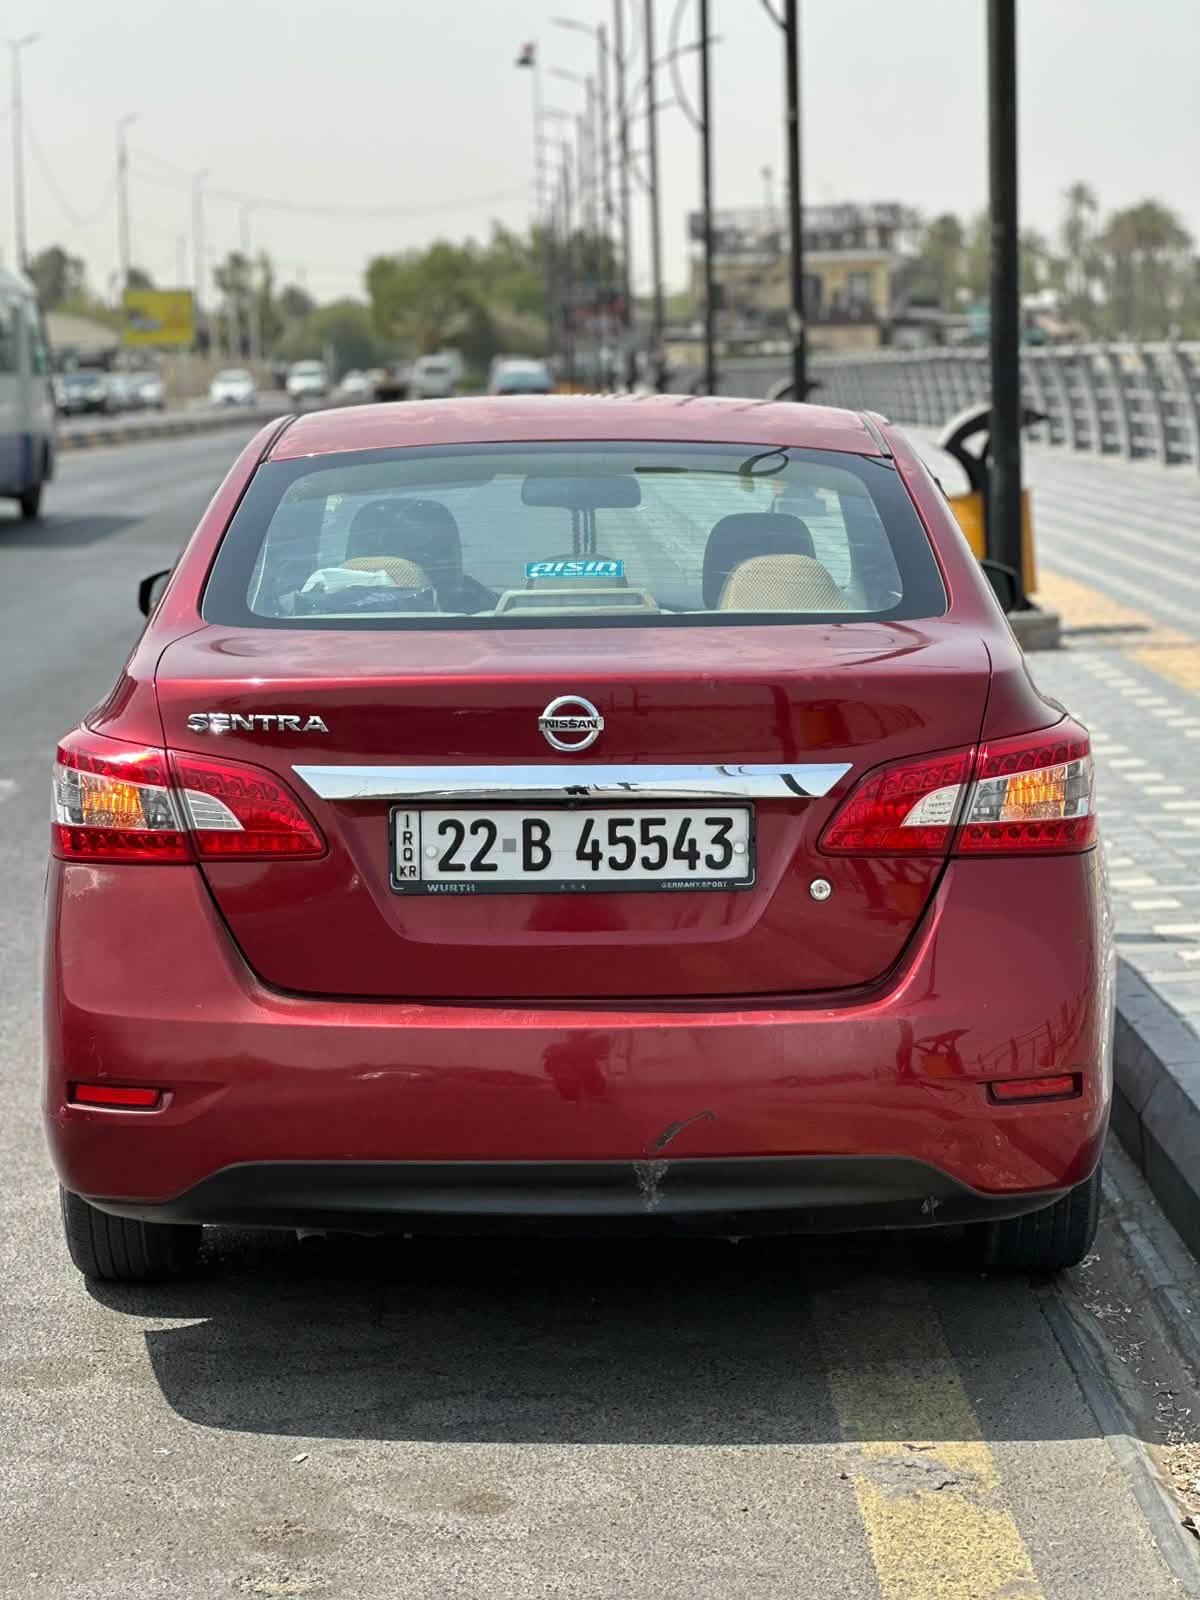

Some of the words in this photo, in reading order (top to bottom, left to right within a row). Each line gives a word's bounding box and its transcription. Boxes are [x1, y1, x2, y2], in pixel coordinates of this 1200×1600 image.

[187, 712, 329, 733] SENTRA
[544, 719, 598, 729] NISSAN
[438, 818, 498, 872] 22
[522, 818, 552, 872] B
[576, 817, 733, 871] 45543
